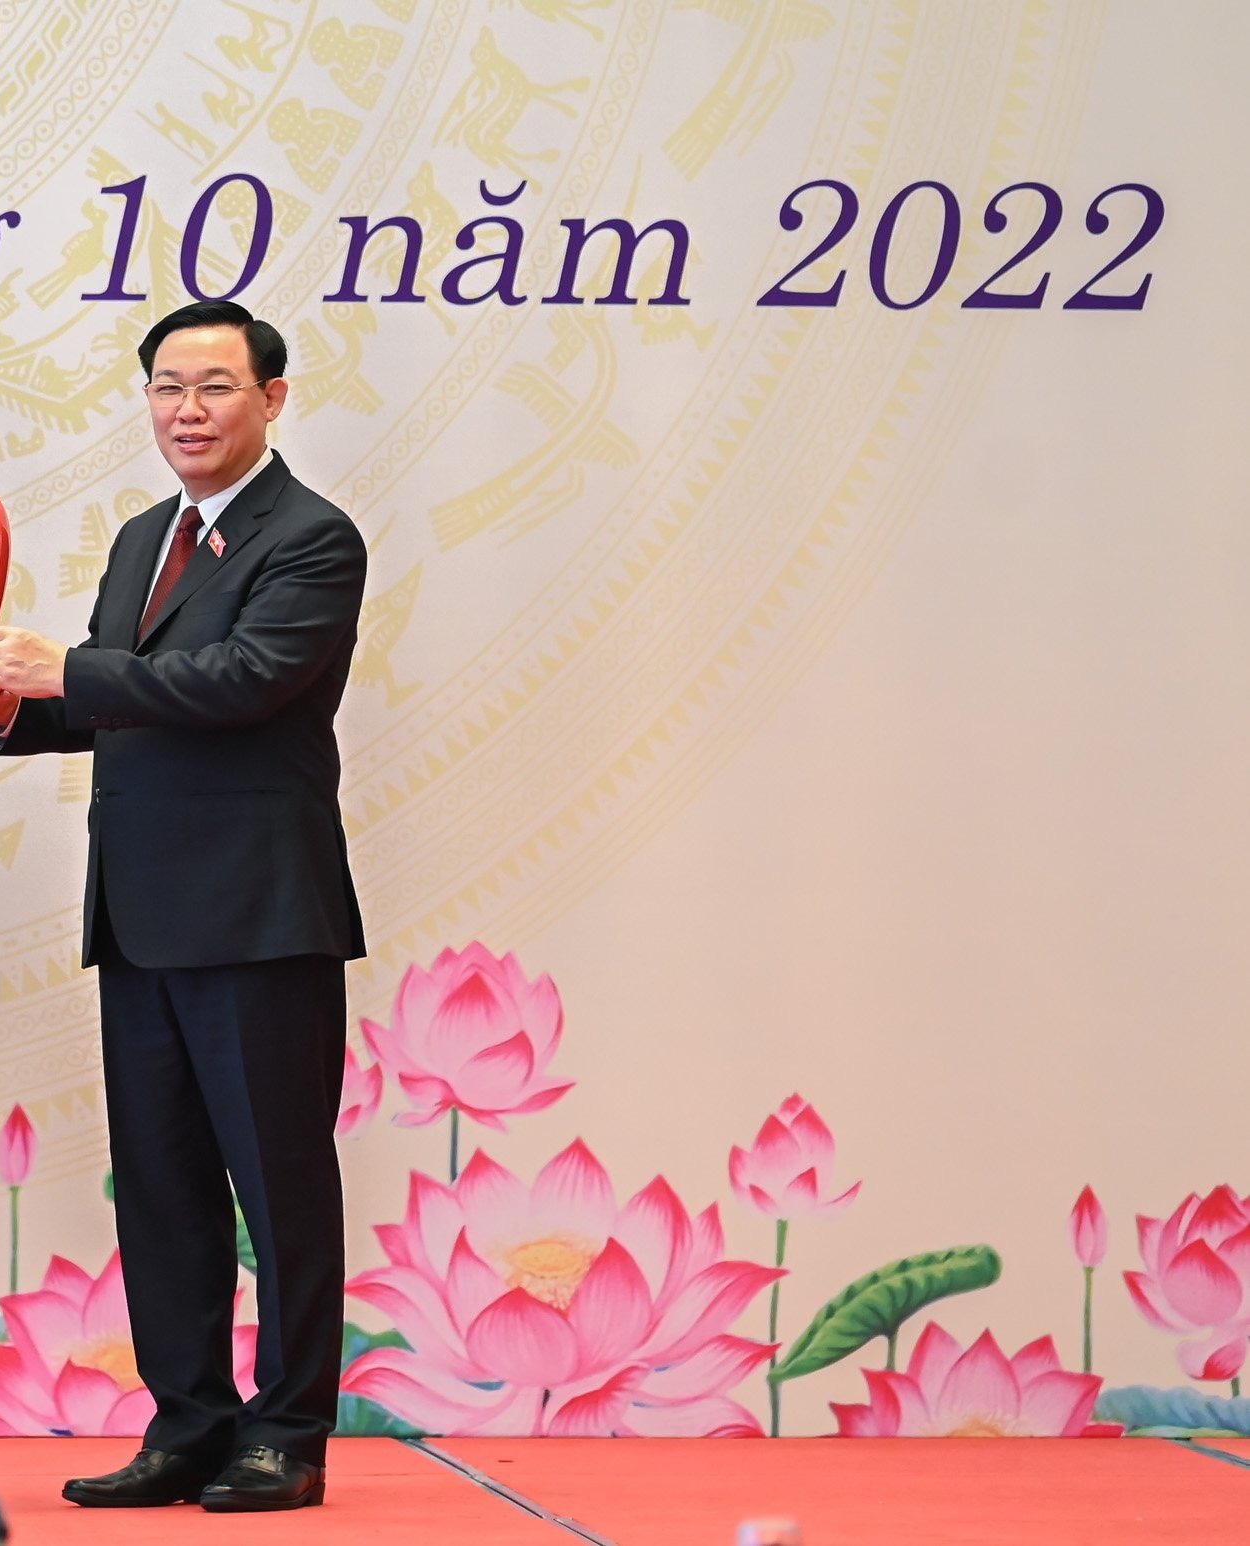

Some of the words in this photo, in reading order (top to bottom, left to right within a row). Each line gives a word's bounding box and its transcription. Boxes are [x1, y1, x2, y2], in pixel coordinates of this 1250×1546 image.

[81, 173, 274, 304] 10
[322, 179, 690, 306] năm
[756, 179, 1166, 310] 2022
